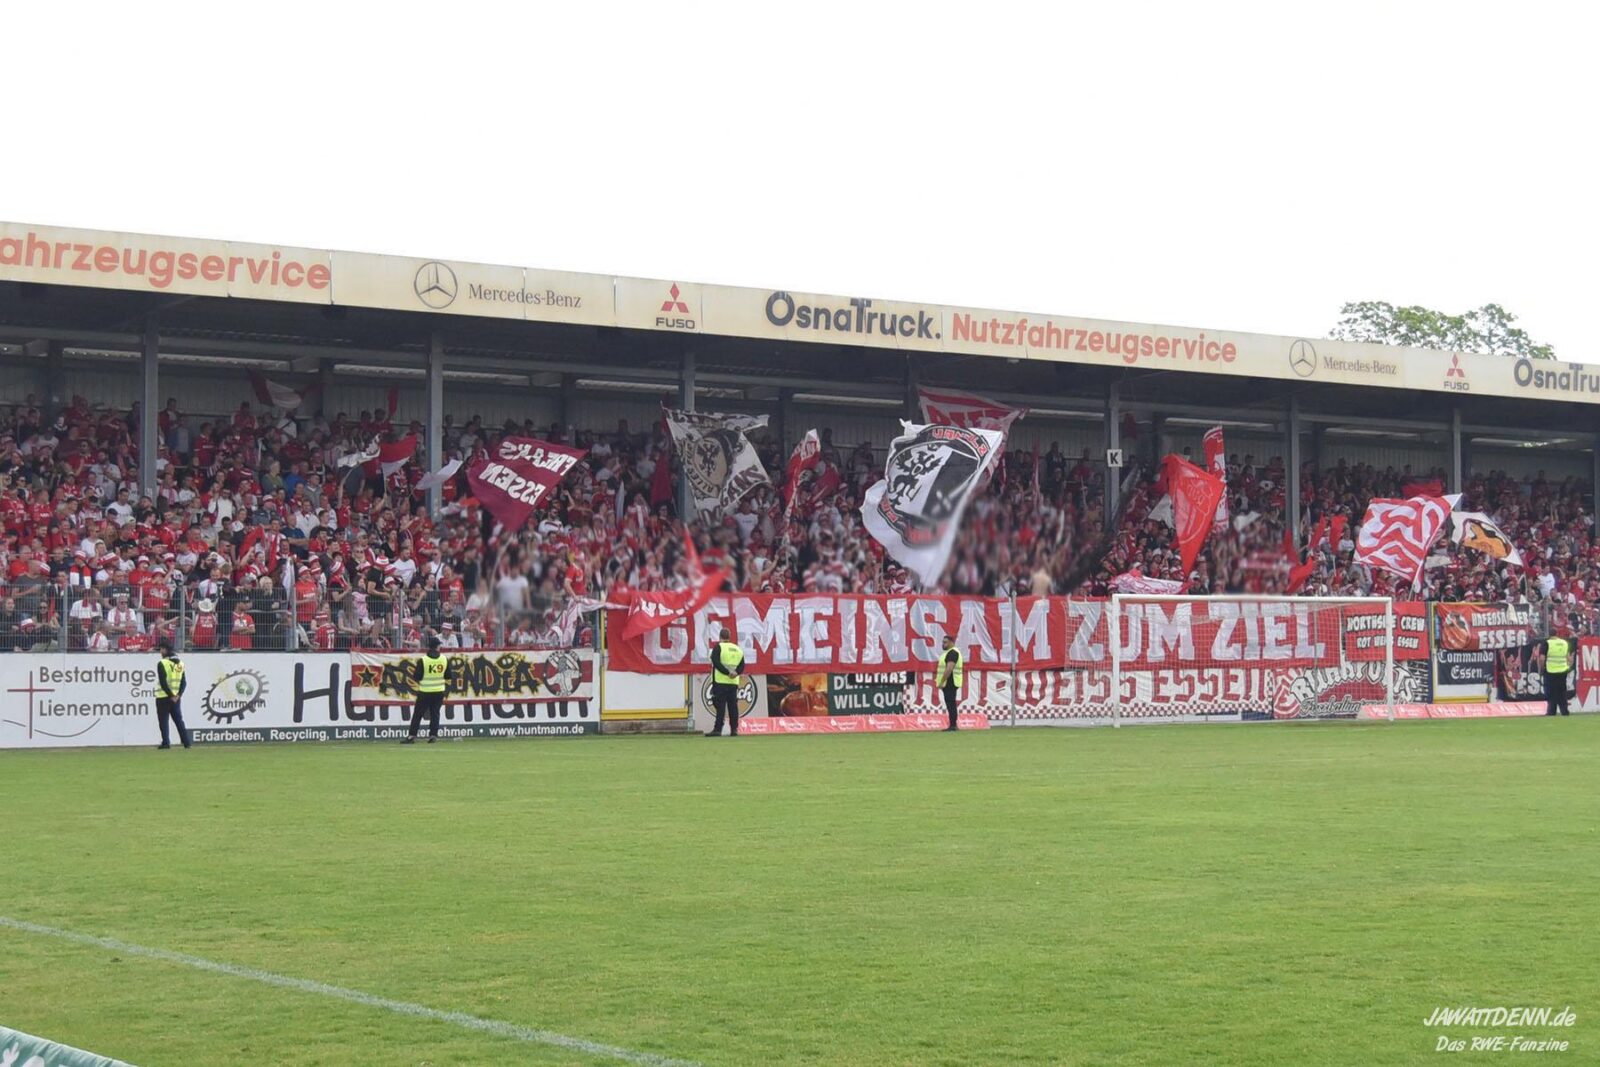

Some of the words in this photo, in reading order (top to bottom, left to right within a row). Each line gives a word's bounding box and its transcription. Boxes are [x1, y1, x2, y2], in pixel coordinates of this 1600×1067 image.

[468, 283, 581, 309] Mercedes-Benz
[655, 316, 695, 331] FUSO
[952, 312, 1236, 368] Nutzfahrzeugservice
[1323, 355, 1397, 377] Mercedes-Benz
[1443, 379, 1470, 391] FUSO
[1109, 451, 1119, 465] K
[643, 597, 1051, 665] GEMEINSAM
[1068, 600, 1195, 662] ZUM
[1208, 601, 1325, 660] ZIEL
[1347, 614, 1397, 632] NORTHSIE
[1438, 648, 1494, 663] Commando
[39, 666, 157, 687] Bestattunge
[429, 664, 444, 674] K9
[1451, 666, 1483, 680] Essen
[39, 699, 149, 717] Lienemann
[212, 698, 266, 709] Huntmann
[834, 693, 870, 710] WILL
[193, 729, 265, 743] Erdarbeiten,
[270, 728, 330, 743] Recycling,
[335, 727, 370, 740] Landt.
[489, 724, 584, 737] www.huntmann.de
